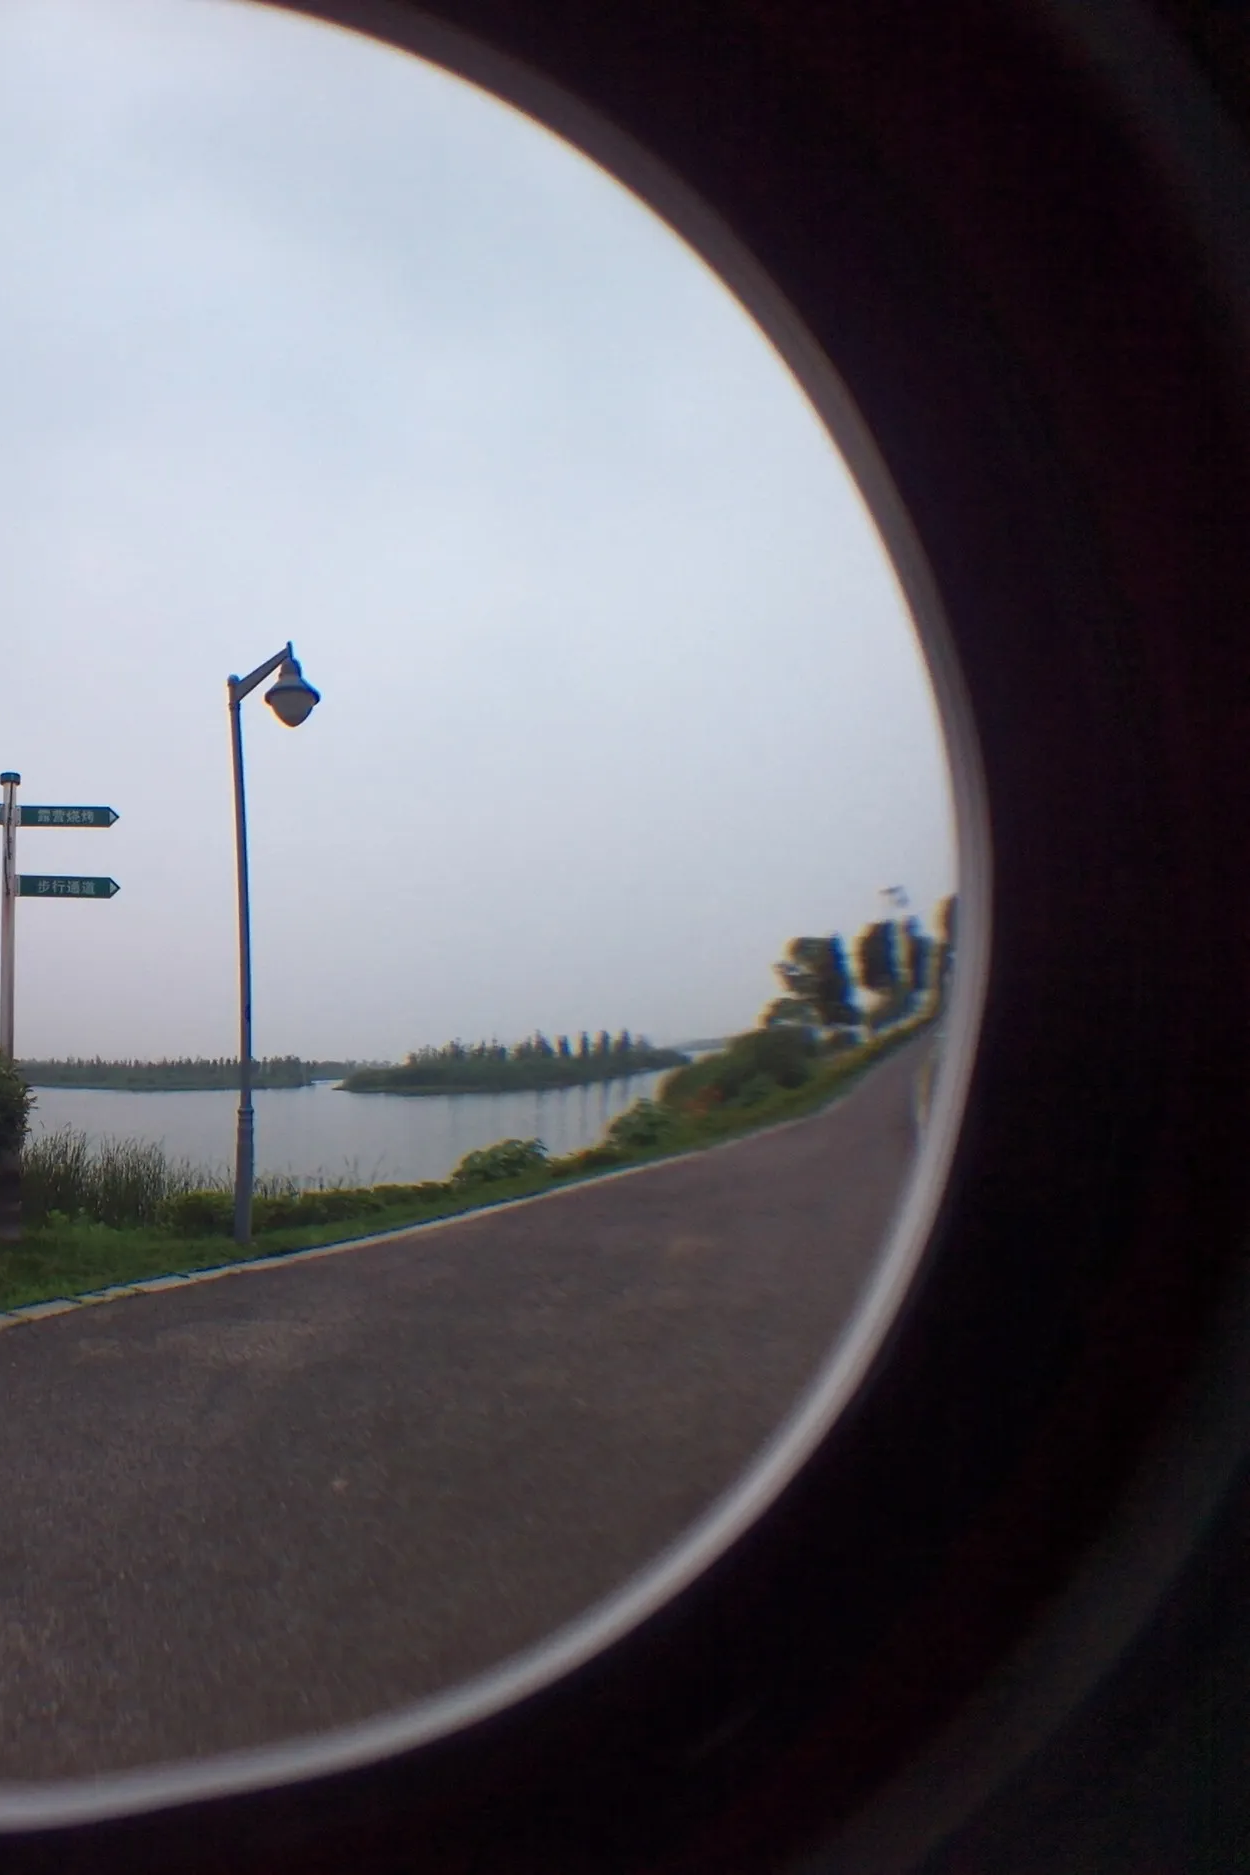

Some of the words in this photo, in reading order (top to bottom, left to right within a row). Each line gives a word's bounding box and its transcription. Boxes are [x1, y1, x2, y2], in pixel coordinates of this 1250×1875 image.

[37, 809, 94, 824] 露营烧烤
[37, 879, 96, 896] 步行通道
